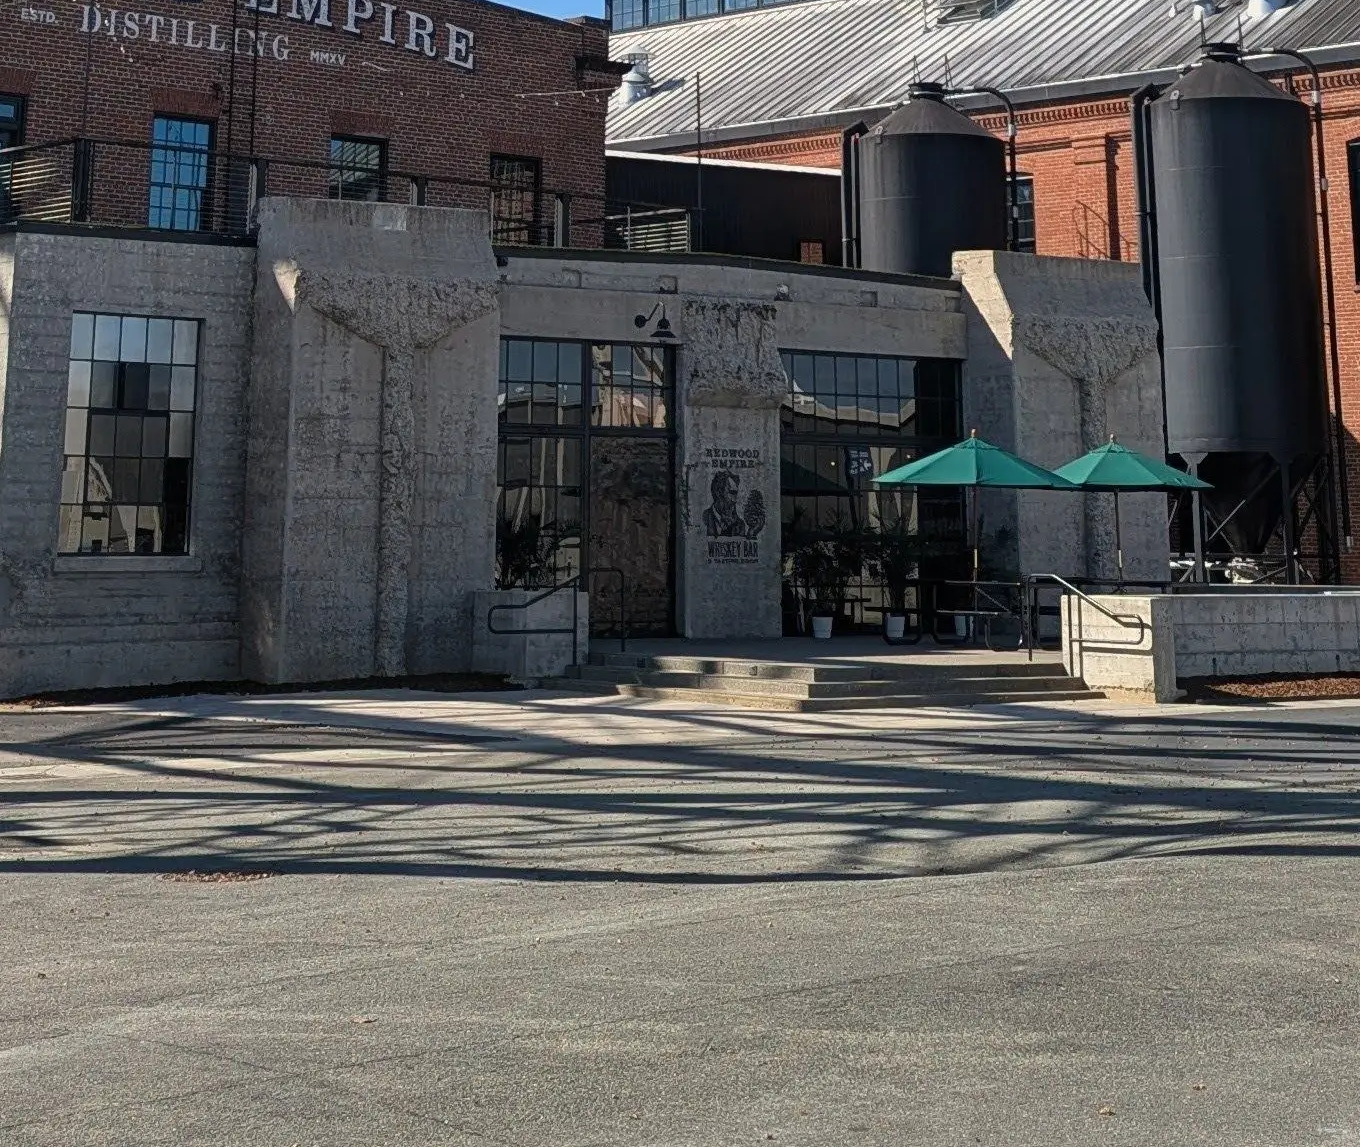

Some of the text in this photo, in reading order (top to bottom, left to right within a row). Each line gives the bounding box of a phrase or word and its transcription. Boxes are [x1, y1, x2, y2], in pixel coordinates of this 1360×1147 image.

[21, 6, 59, 24] ESTD.
[310, 50, 347, 66] MMXV
[705, 448, 759, 458] REDWOOD
[711, 459, 755, 468] EMPIRE
